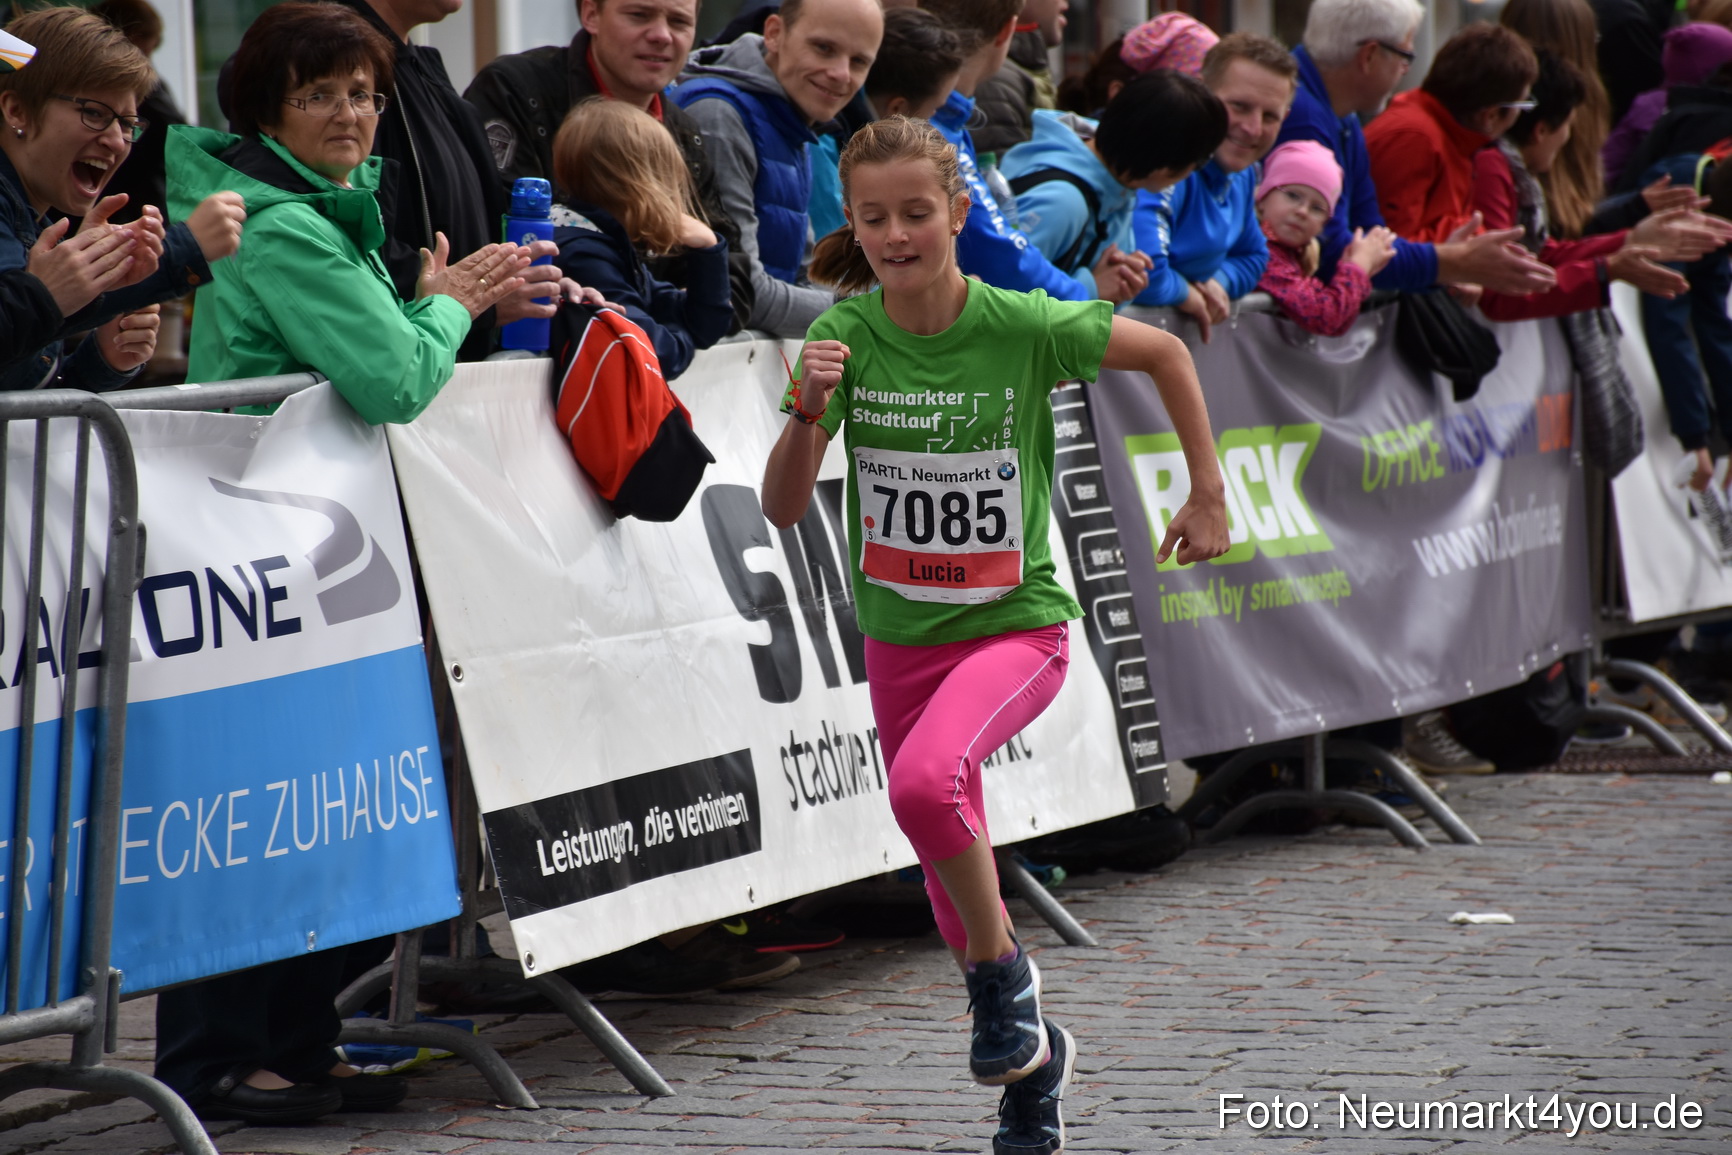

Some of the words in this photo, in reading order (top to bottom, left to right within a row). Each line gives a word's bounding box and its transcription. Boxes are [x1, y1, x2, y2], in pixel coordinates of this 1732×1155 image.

[853, 386, 966, 406] Neumarkter
[852, 408, 943, 432] Stadtlauf
[859, 459, 907, 481] PARTL
[912, 467, 991, 483] Neumarkt
[873, 484, 1007, 546] 7085
[867, 531, 873, 540] 5
[1008, 538, 1015, 548] K
[908, 558, 966, 583] Lucia
[1219, 576, 1245, 623] by
[264, 745, 439, 859] ZUHAUSE
[644, 805, 676, 848] die
[674, 791, 750, 839] verbinden
